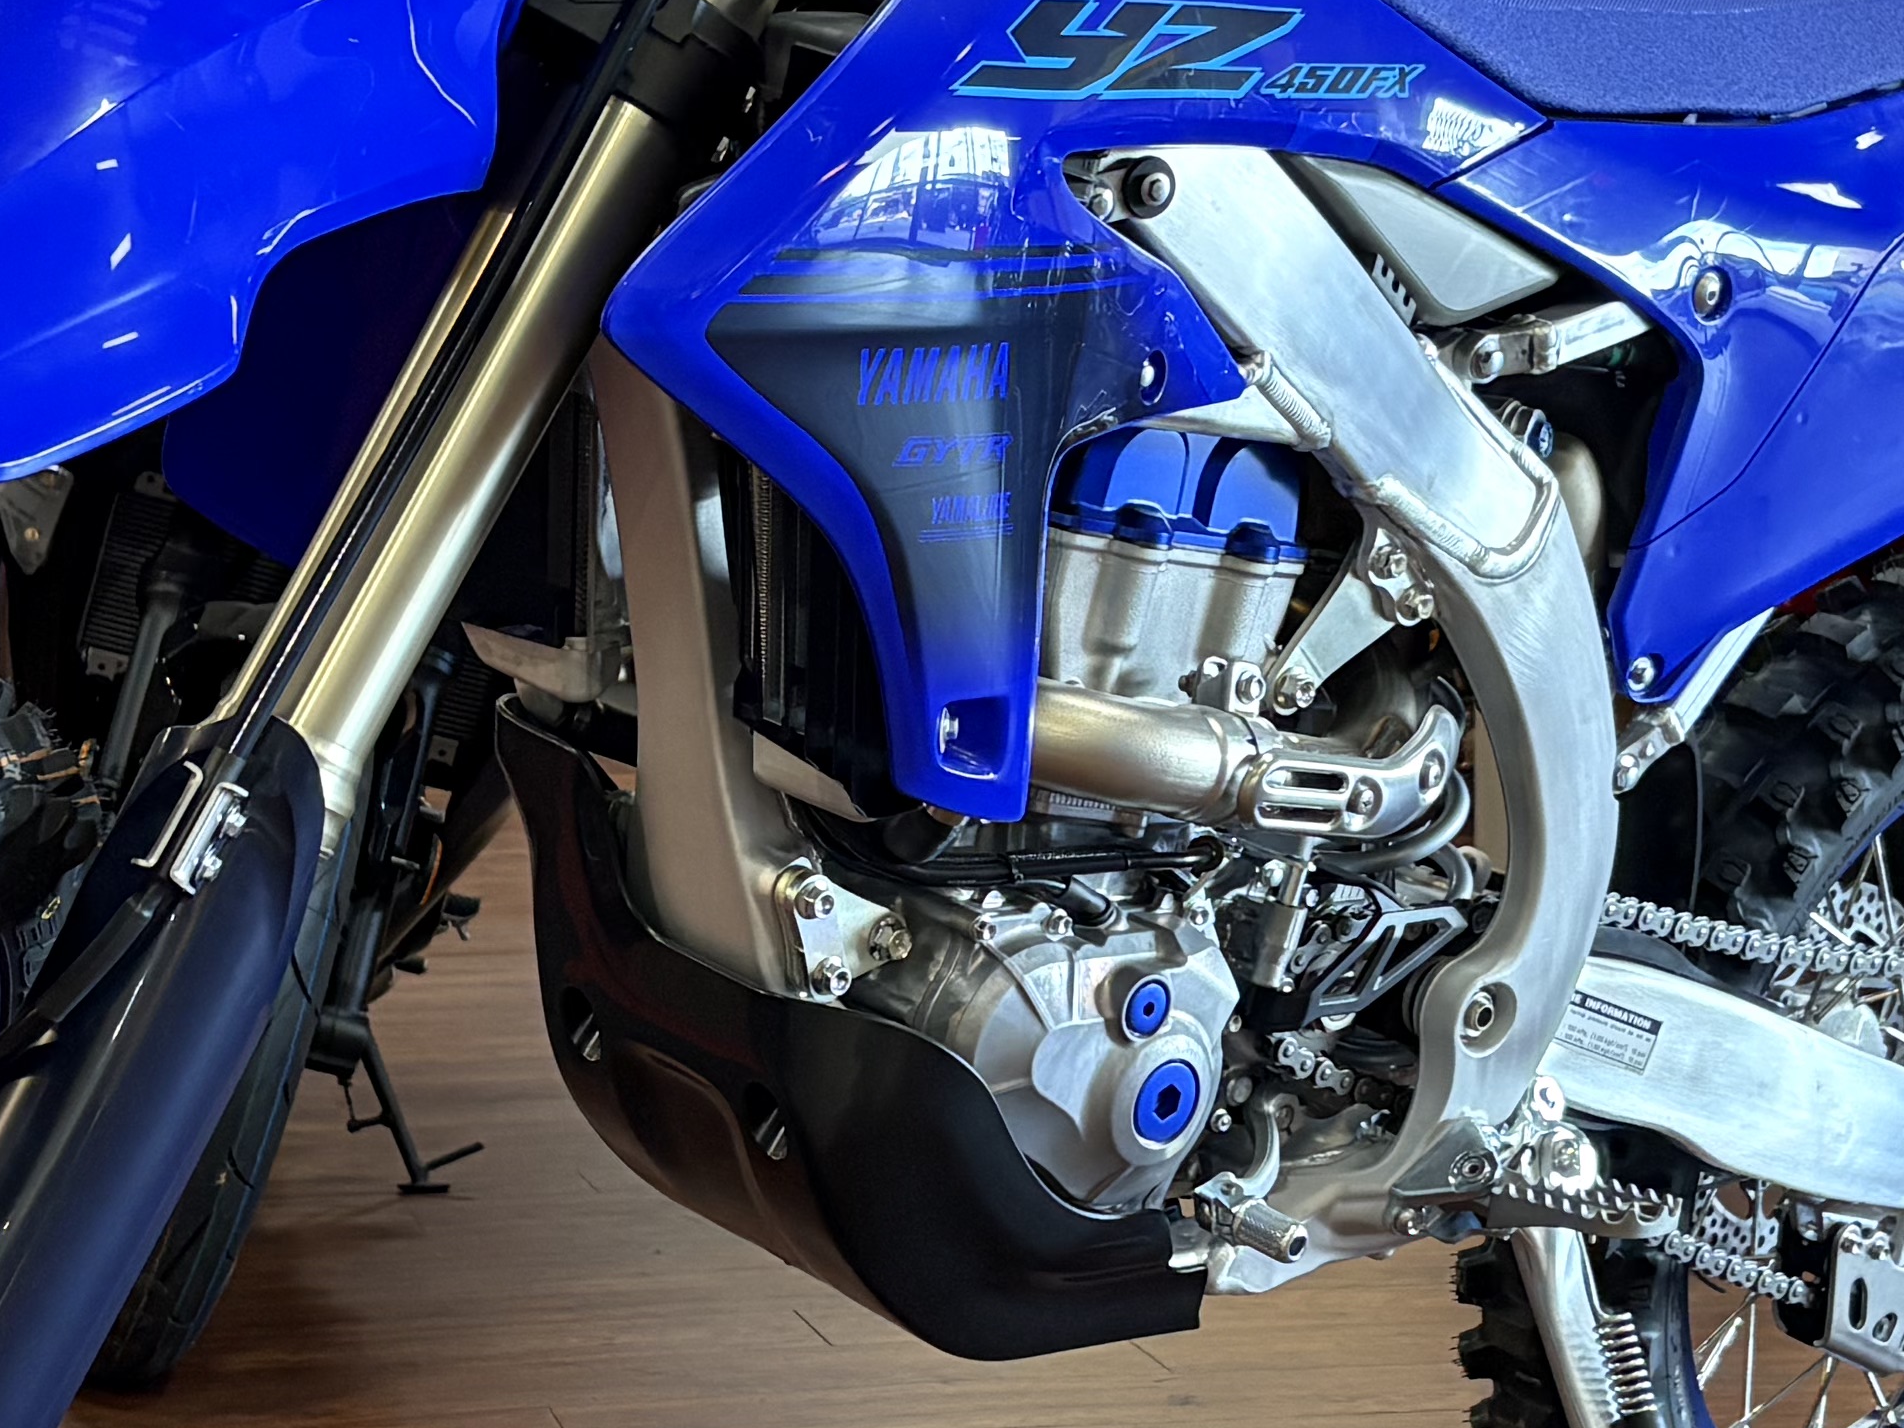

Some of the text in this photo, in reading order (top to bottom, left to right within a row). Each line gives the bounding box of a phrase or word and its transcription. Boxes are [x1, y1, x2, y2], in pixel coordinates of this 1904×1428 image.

[1259, 63, 1426, 100] 450FX
[856, 341, 1010, 406] YAMAHA
[892, 431, 1014, 467] GYTR
[1584, 997, 1652, 1031] INFORMATION
